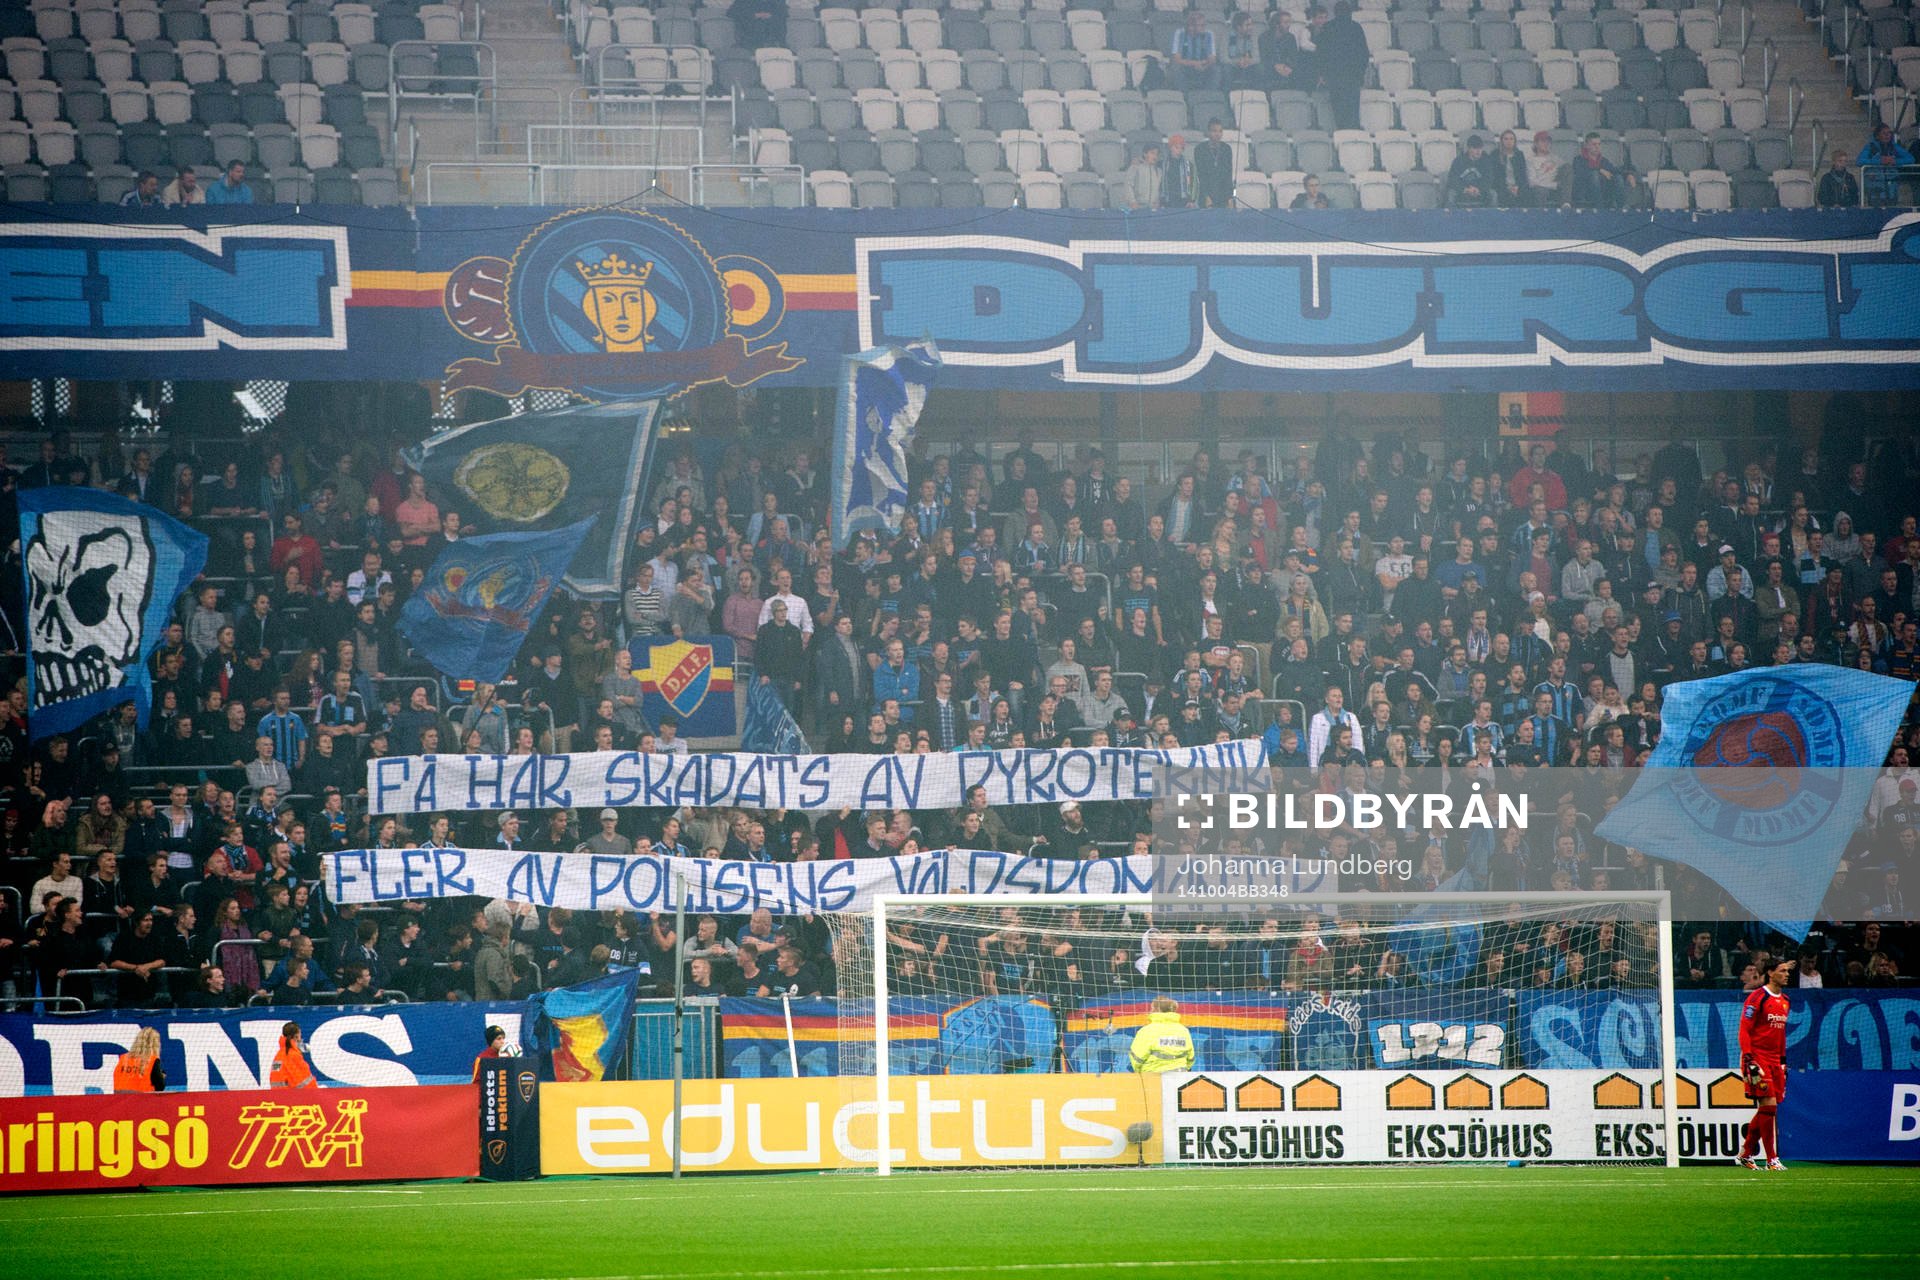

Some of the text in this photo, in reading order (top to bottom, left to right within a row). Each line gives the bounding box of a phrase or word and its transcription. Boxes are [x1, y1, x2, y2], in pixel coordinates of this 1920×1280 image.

[376, 737, 1271, 813] FÅ HAR SKADATS AV PYROTEKNIK
[333, 848, 475, 903] FLER
[508, 853, 563, 906] AV
[590, 855, 857, 916] POLISENS
[1377, 1022, 1505, 1066] 1312
[486, 1070, 496, 1132] idrotts
[498, 1069, 509, 1131] reklam
[576, 1081, 1129, 1168] eductus
[0, 1104, 210, 1179] ringsö
[228, 1099, 369, 1169] TRÄ
[1178, 1118, 1345, 1160] EKSJÖHUS
[1387, 1118, 1552, 1159] EKSJÖHUS
